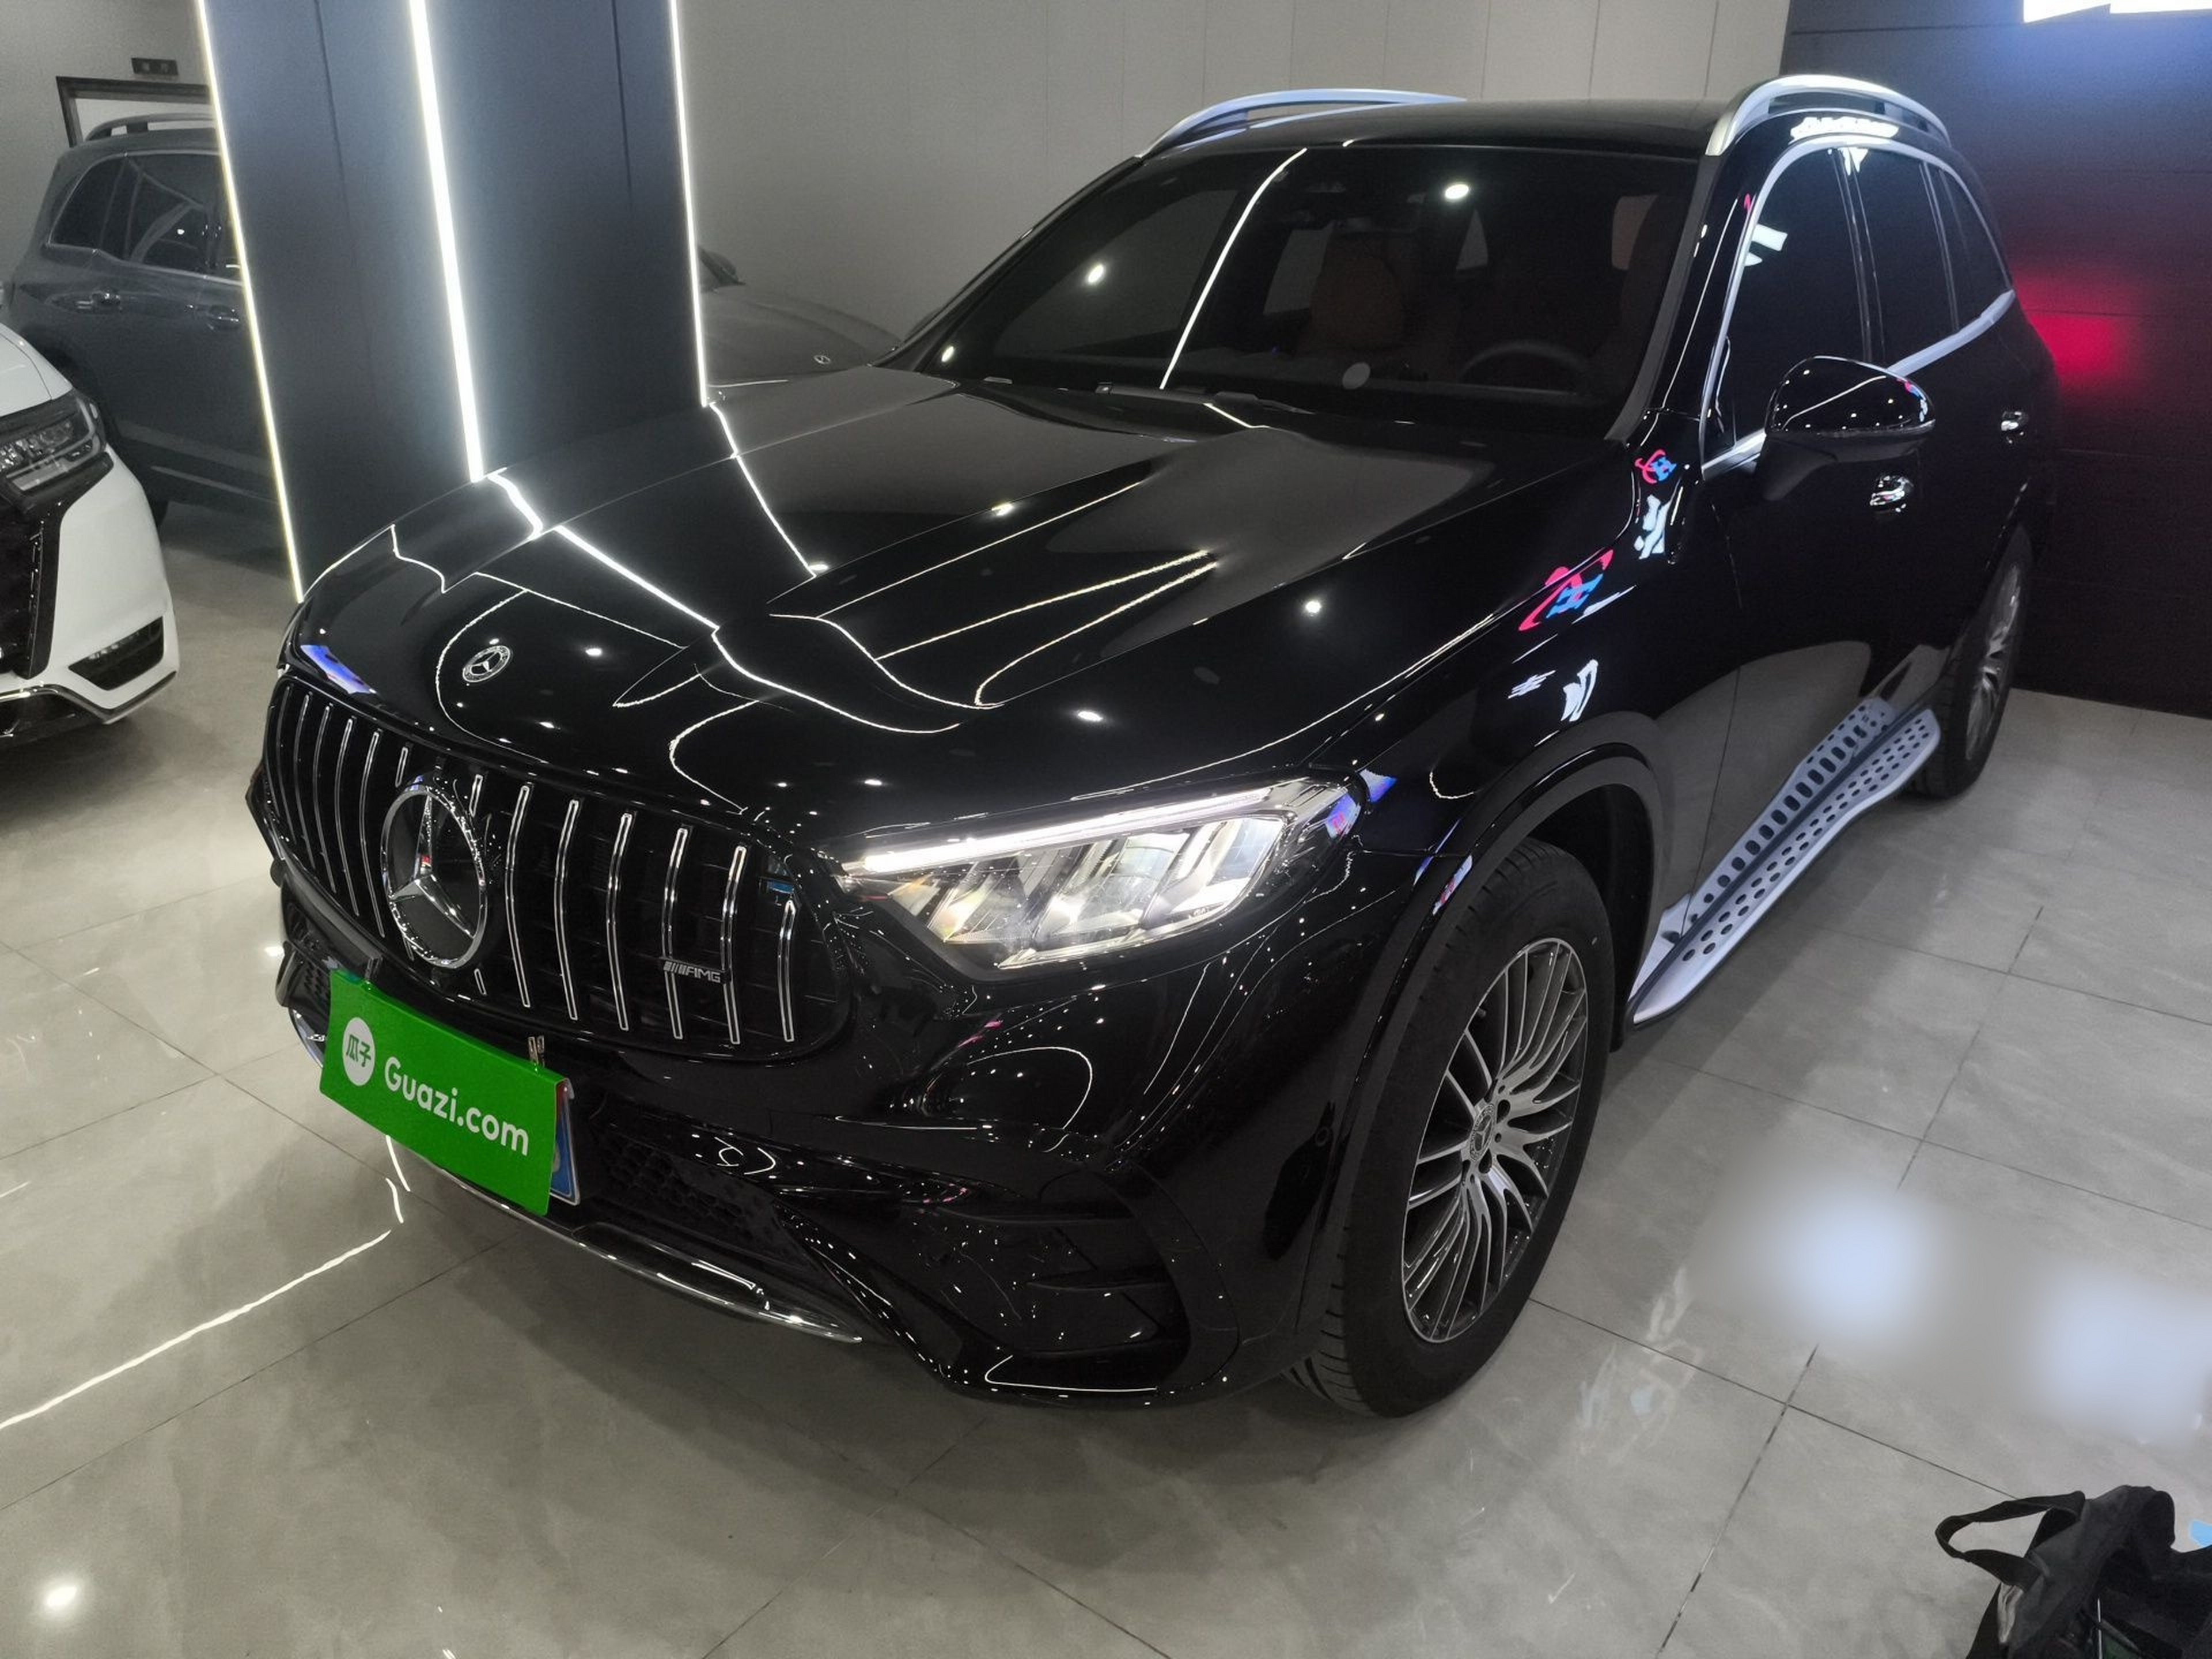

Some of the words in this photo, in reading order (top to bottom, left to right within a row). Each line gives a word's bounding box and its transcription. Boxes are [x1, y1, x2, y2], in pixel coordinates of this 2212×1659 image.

[684, 965, 721, 984] AMG
[346, 1035, 372, 1067] 瓜子
[384, 1056, 529, 1156] Guazi.com
